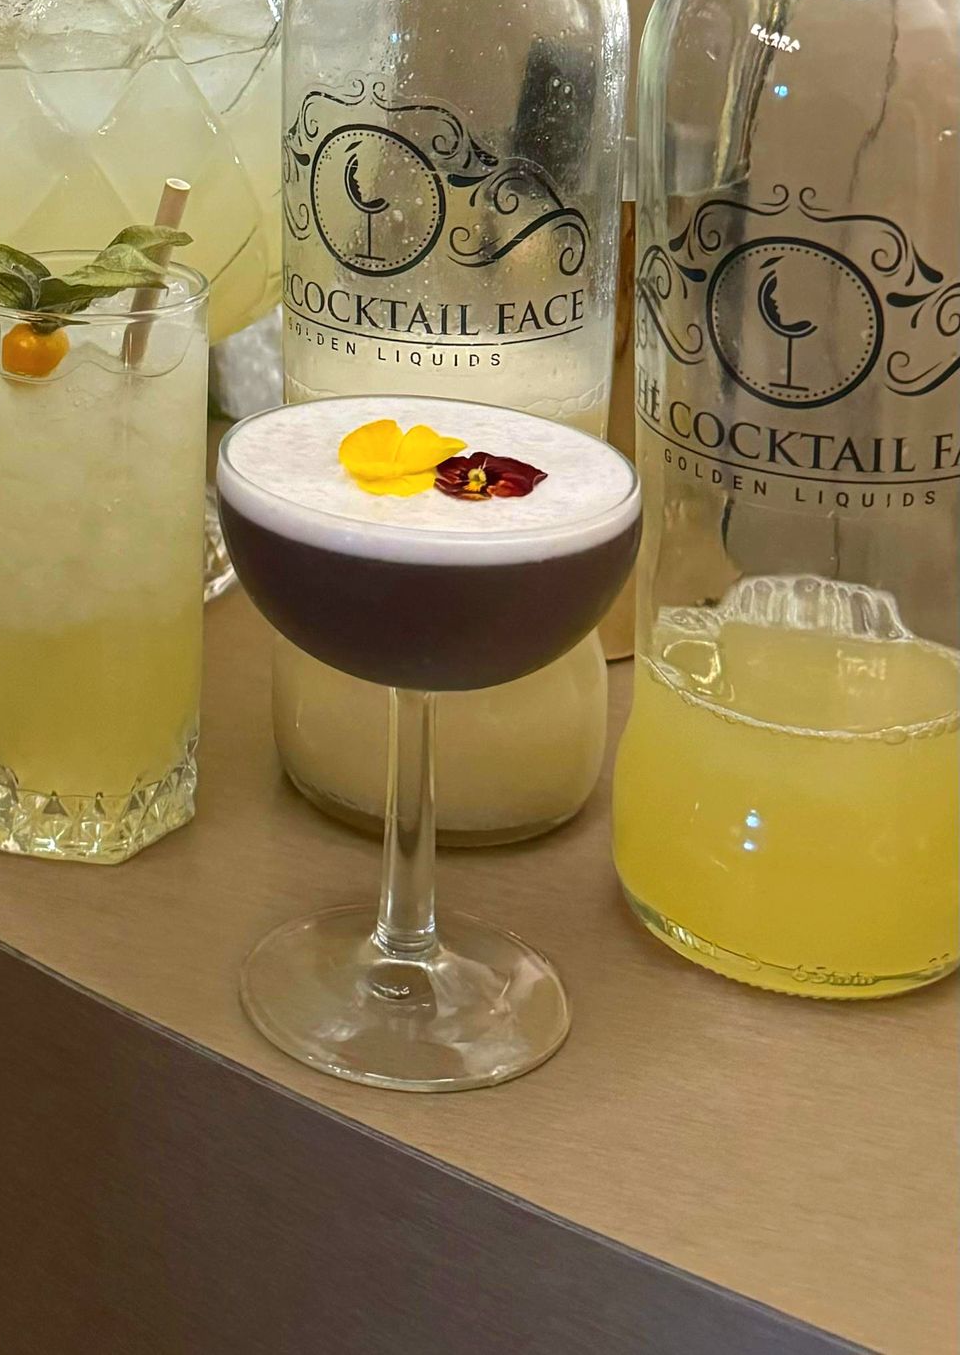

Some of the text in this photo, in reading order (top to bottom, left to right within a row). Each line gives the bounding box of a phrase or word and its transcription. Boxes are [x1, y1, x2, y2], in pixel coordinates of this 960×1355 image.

[290, 273, 480, 336] COCKTAIL
[496, 289, 584, 335] FACE
[377, 347, 502, 367] LIQUIDS
[669, 400, 917, 474] COCKTAIL
[664, 447, 936, 509] GOLDEN LIQUIDS
